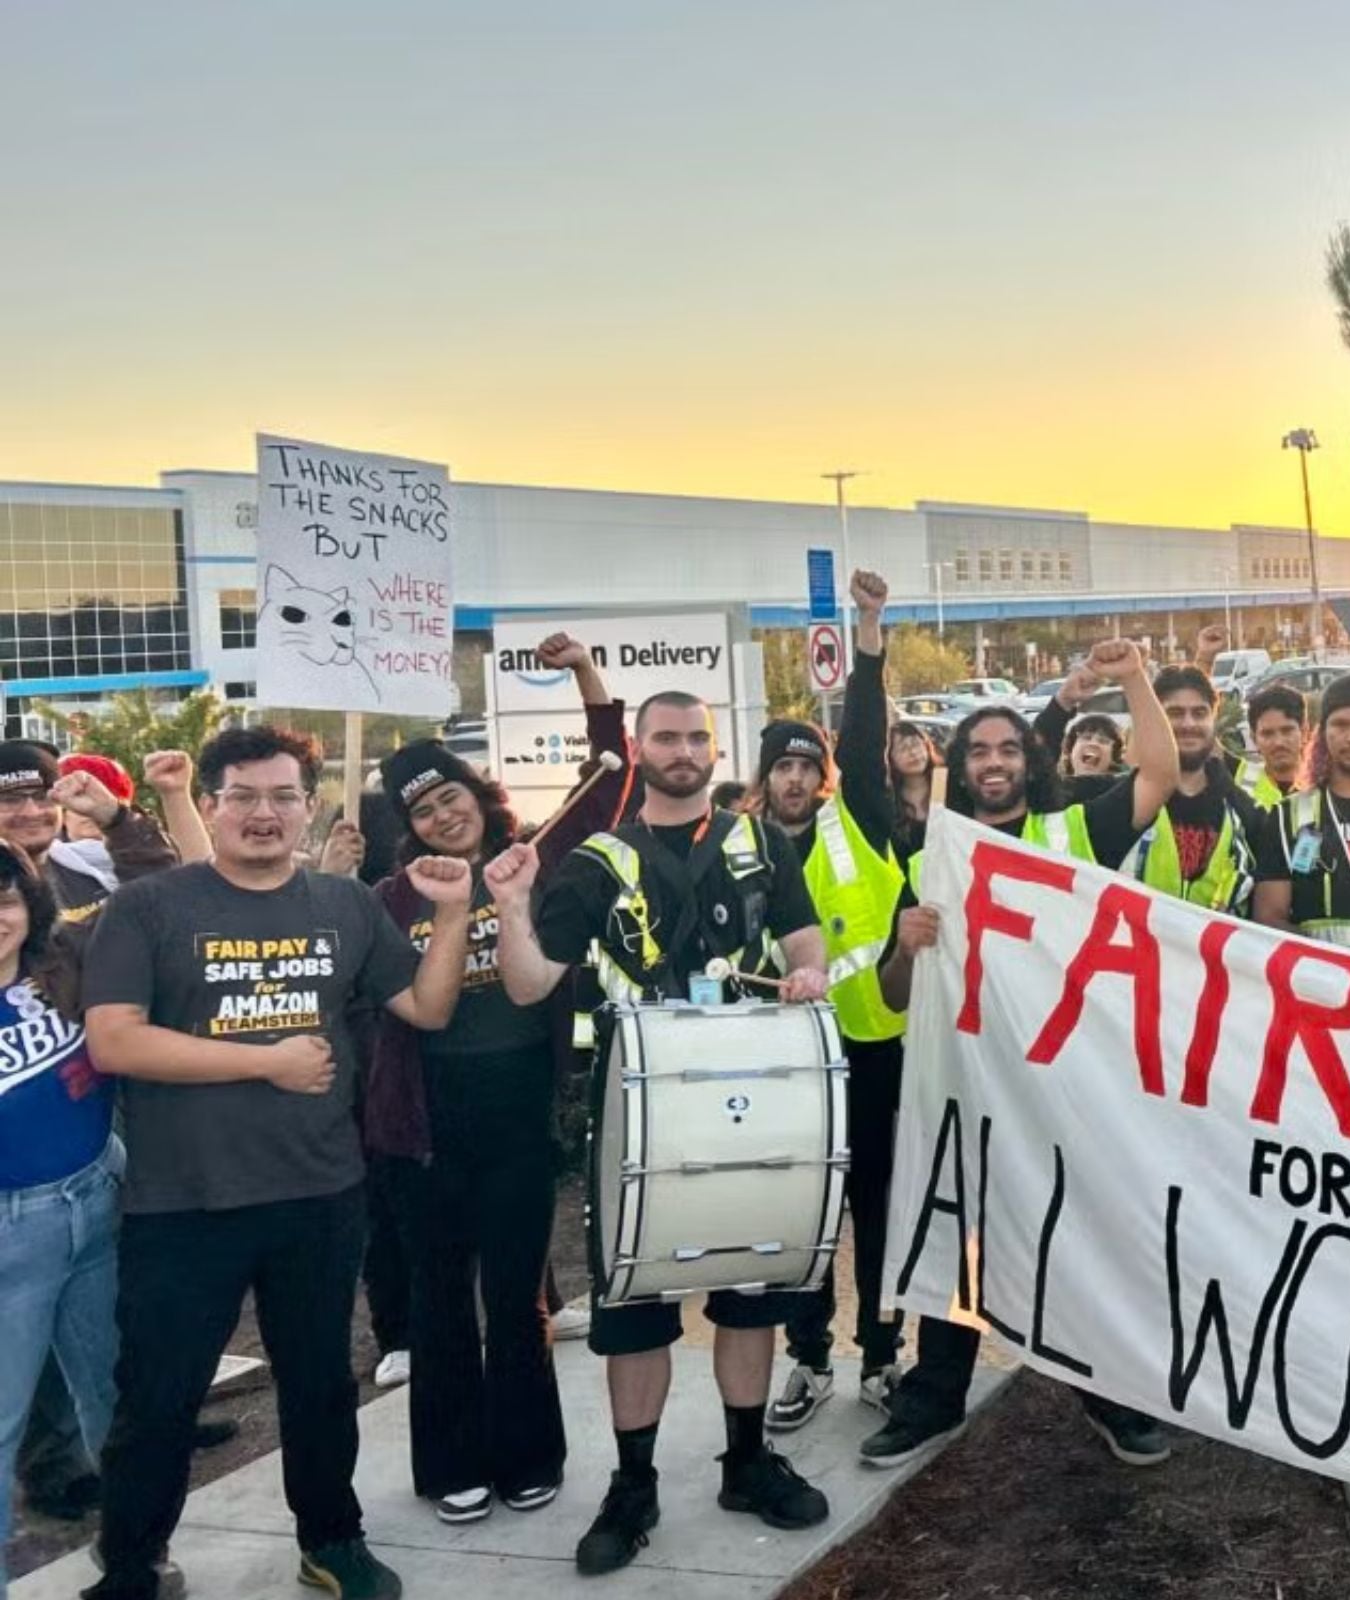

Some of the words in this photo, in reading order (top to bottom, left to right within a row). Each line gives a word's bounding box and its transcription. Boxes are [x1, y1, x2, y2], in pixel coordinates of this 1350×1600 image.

[265, 445, 384, 493] THANKS
[388, 469, 449, 510] FOR
[268, 483, 335, 516] THE
[348, 497, 448, 542] SNACKS
[303, 522, 388, 561] BUT
[367, 572, 448, 608] WHERE
[369, 607, 394, 632] IS
[398, 611, 447, 638] THE
[620, 641, 722, 670] Delivery
[205, 940, 258, 960] FAIR
[262, 938, 309, 958] PAY
[314, 938, 331, 955] &
[204, 961, 264, 982] SAFE
[268, 958, 334, 979] JOBS
[254, 981, 286, 994] for
[218, 990, 319, 1018] AMAZON
[896, 1098, 1093, 1378] ALL
